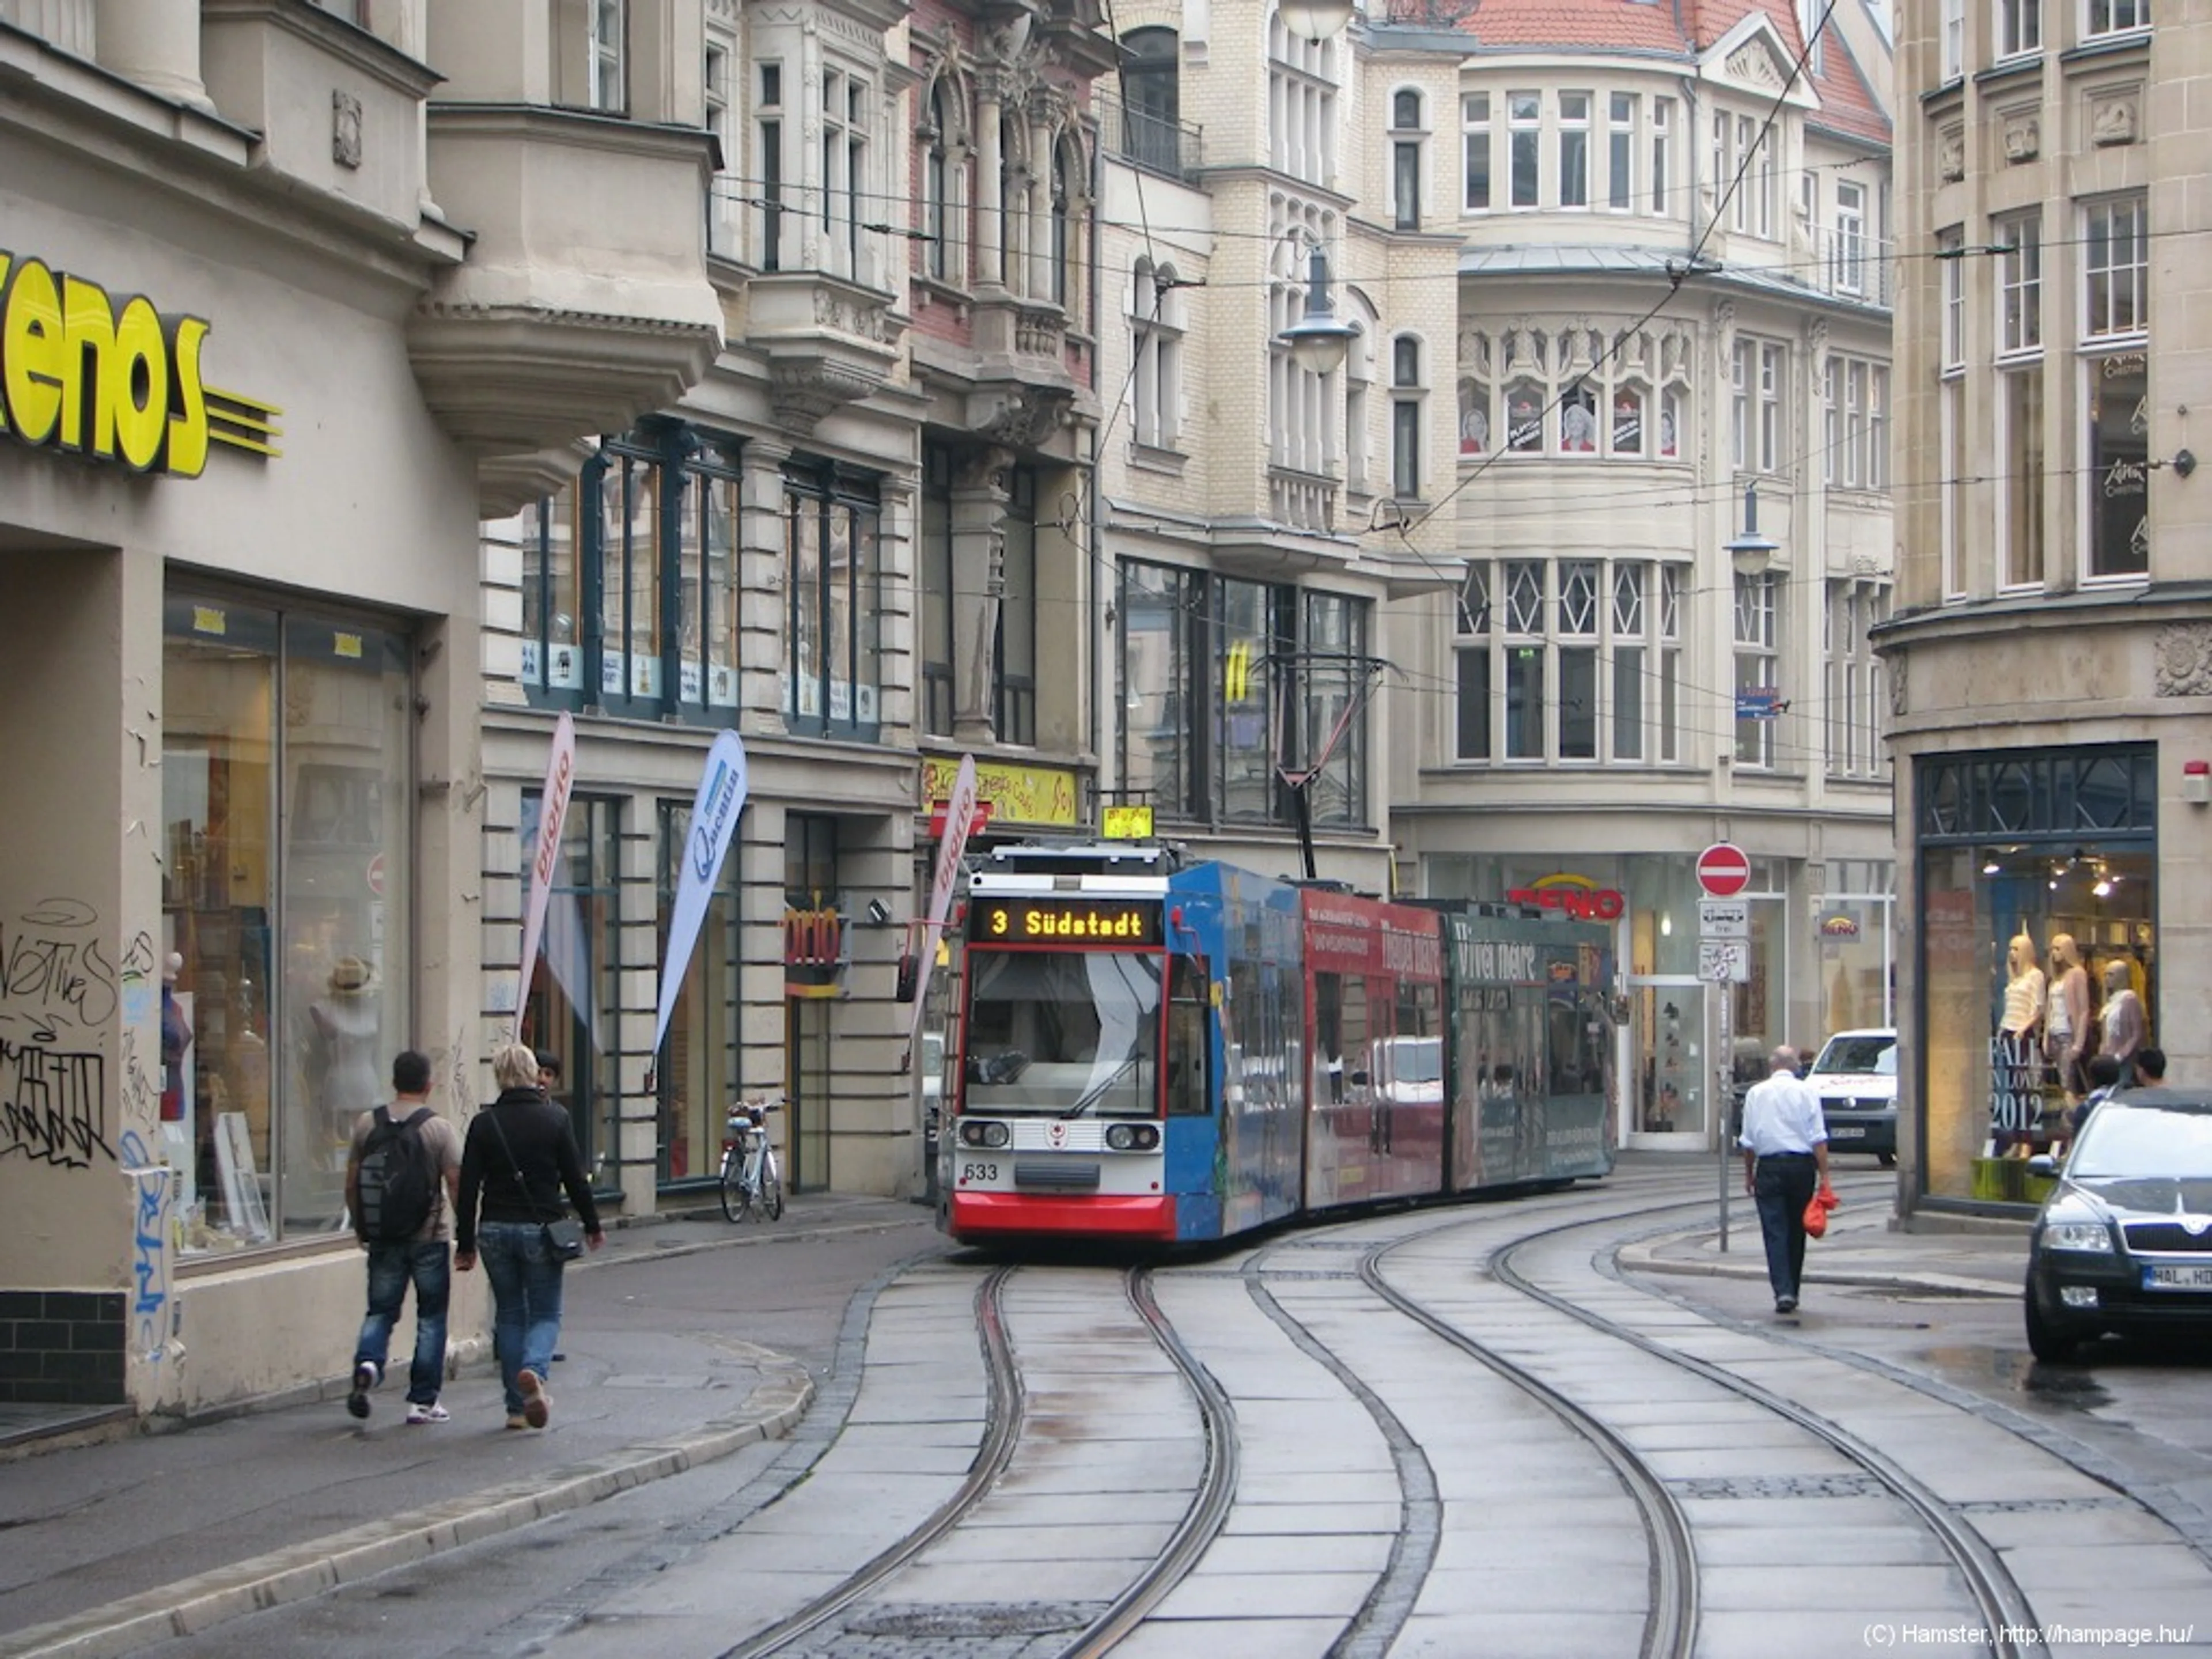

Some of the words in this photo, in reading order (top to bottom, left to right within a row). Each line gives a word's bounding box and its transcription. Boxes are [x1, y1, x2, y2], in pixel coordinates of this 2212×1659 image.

[0, 248, 211, 479] enos
[992, 910, 1008, 934] 3
[1026, 910, 1143, 936] Südstadt
[1988, 1037, 2044, 1066] FALL
[1988, 1092, 2043, 1131] 2012
[2153, 1269, 2183, 1285] HAL
